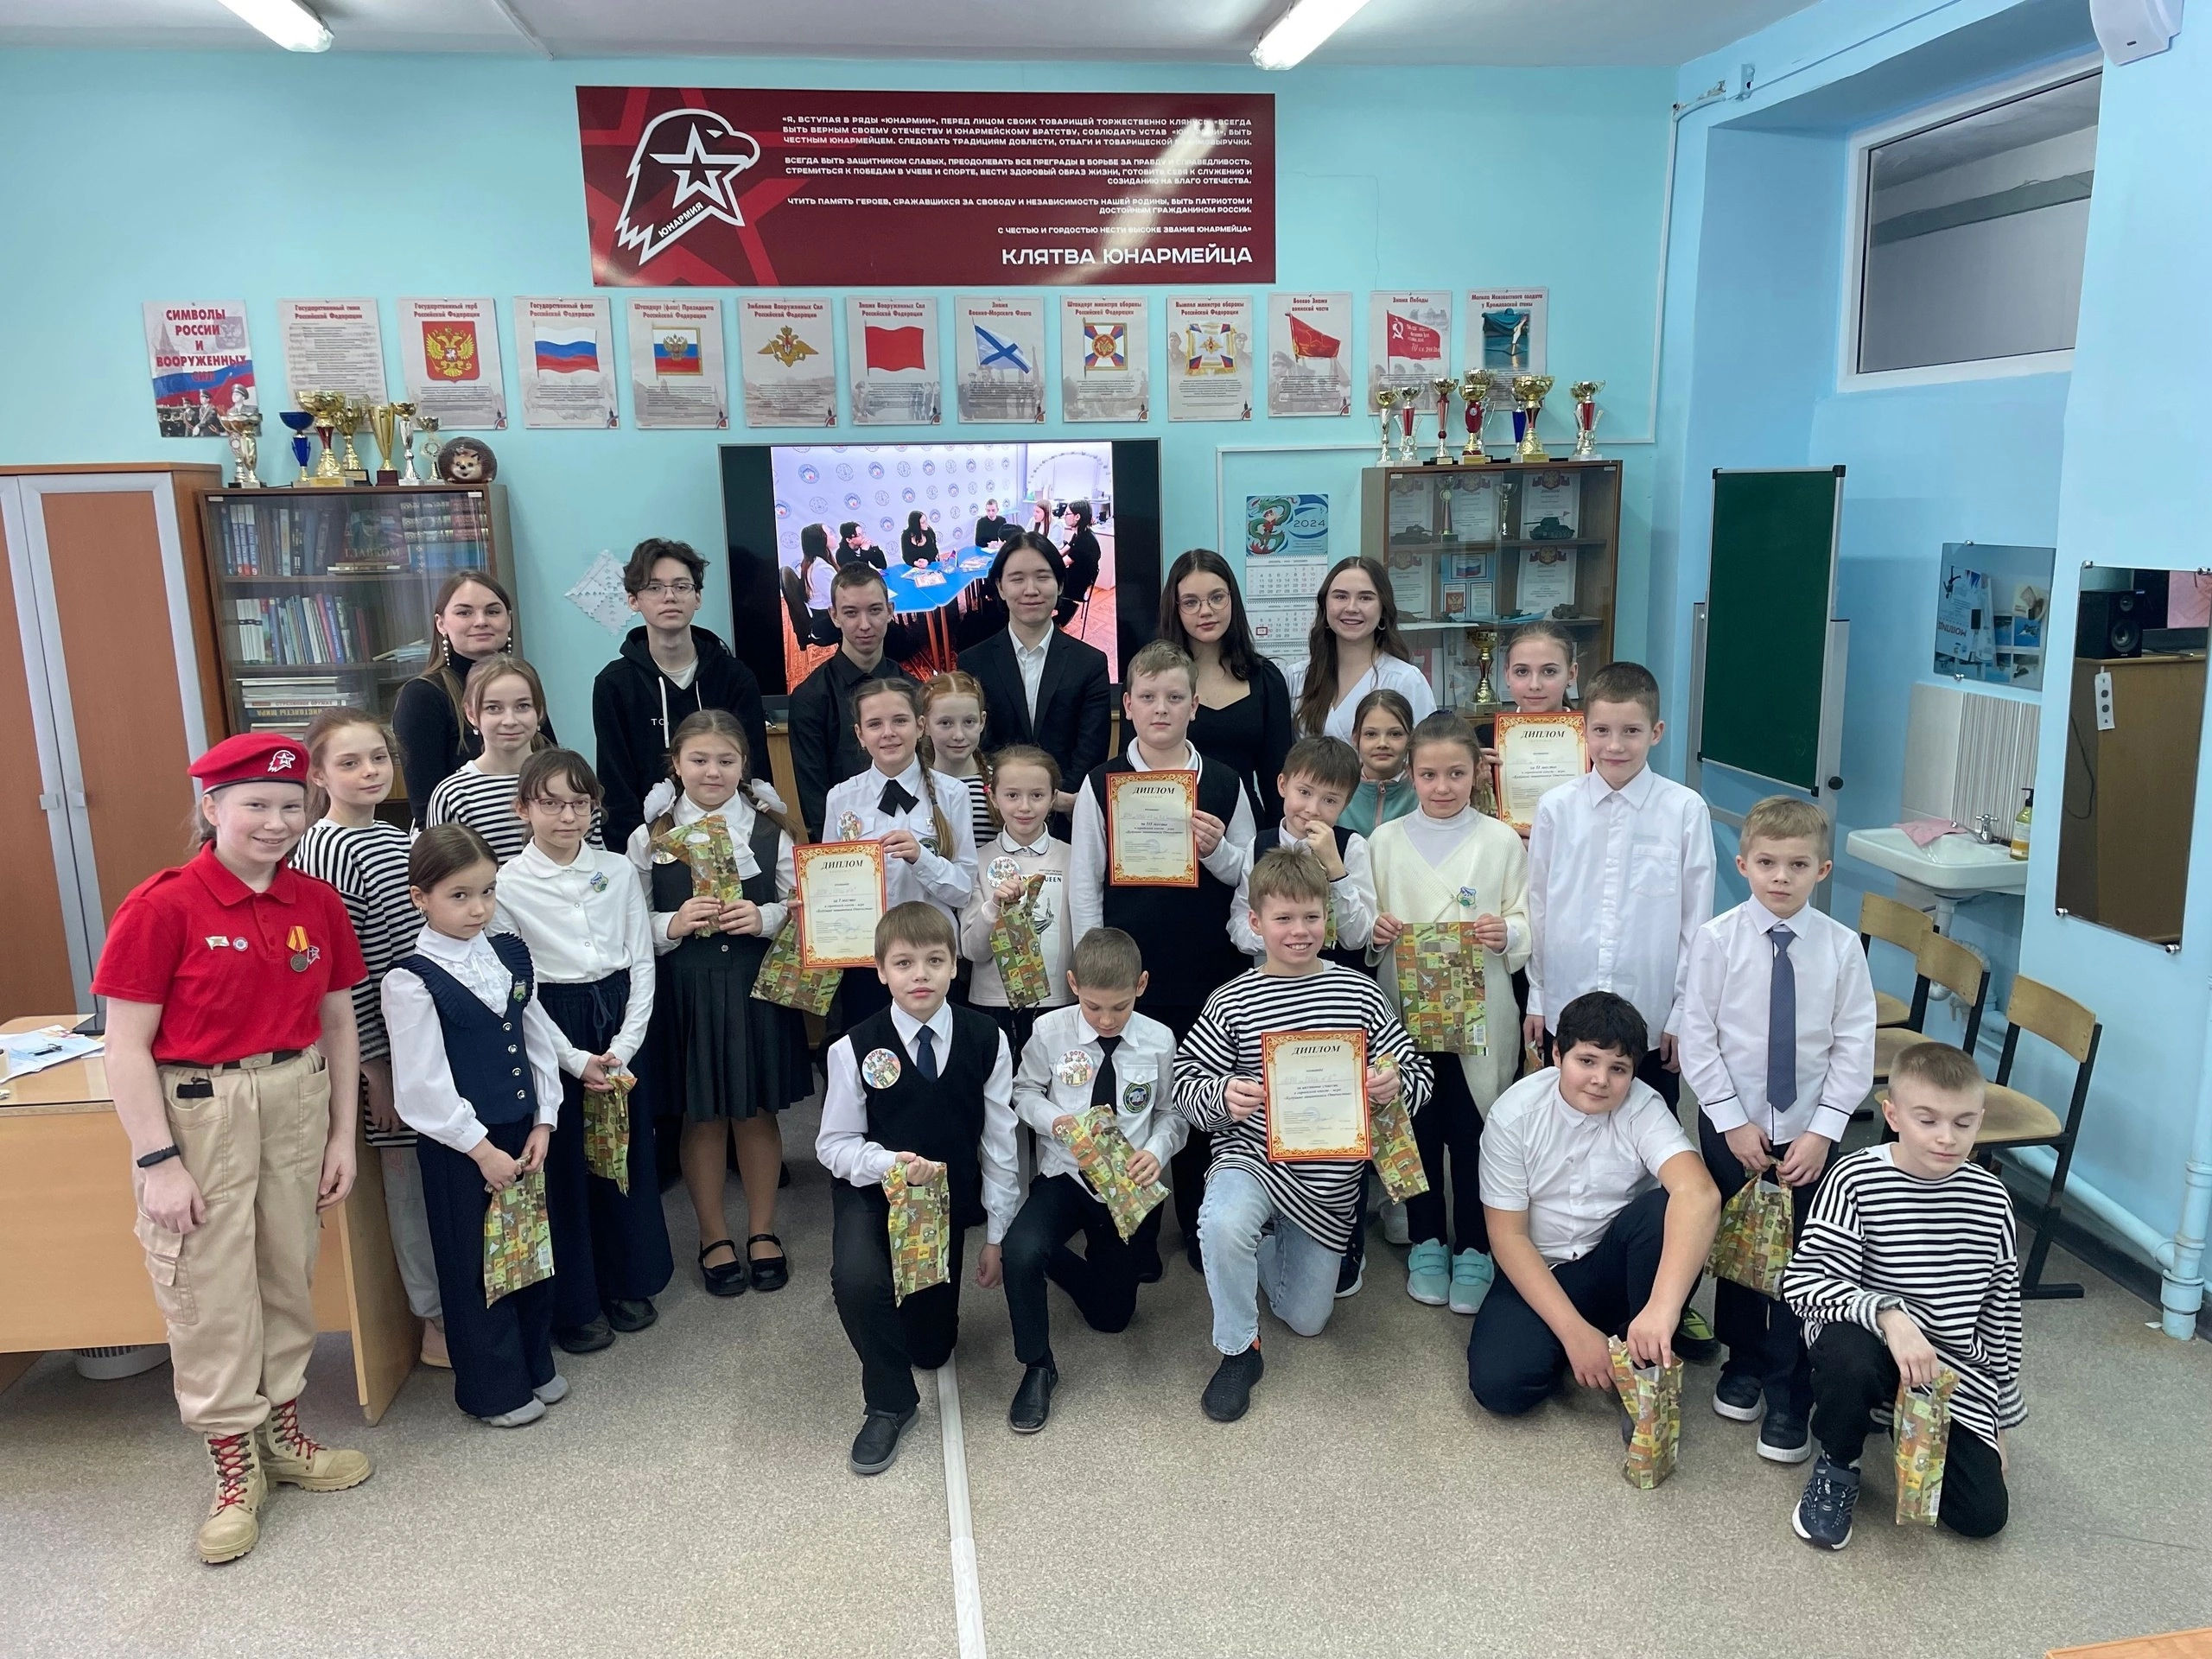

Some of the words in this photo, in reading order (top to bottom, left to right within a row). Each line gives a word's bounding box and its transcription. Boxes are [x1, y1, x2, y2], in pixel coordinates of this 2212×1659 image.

[782, 115, 795, 124] «Я,
[852, 116, 878, 124] РЯДЫ
[940, 117, 970, 125] ПЕРЕД
[1096, 118, 1166, 126] ТОРЖЕСТВЕННО
[810, 125, 849, 134] ВЕРНЫМ
[891, 126, 943, 135] ОТЕЧЕСТВУ
[954, 127, 1029, 136] ЮНАРМЕЙСКОМУ
[1082, 128, 1136, 137] СОБЛЮДАТЬ
[1139, 128, 1167, 137] УСТАВ
[1229, 128, 1252, 137] БЫТЬ
[783, 136, 827, 144] ЧЕСТНЫМ
[898, 137, 950, 145] СЛЕДОВАТЬ
[952, 137, 1006, 146] ТРАДИЦИЯМ
[1008, 137, 1057, 146] ДОБЛЕСТИ,
[1058, 137, 1092, 146] ОТВАГИ
[1102, 138, 1173, 147] ТОВАРИЩЕСКОЙ
[785, 156, 819, 165] ВСЕГДА
[820, 156, 845, 165] БЫТЬ
[846, 156, 906, 165] ЗАЩИТНИКОМ
[948, 157, 1014, 166] ПРЕОДОЛЕВАТЬ
[1120, 158, 1132, 167] ЗА
[785, 166, 843, 175] СТРЕМИТЬСЯ
[853, 167, 895, 175] ПОБЕДАМ
[897, 167, 904, 175] В
[1009, 168, 1056, 176] ЗДОРОВЫЙ
[1058, 168, 1086, 176] ОБРАЗ
[1088, 168, 1120, 176] ЖИЗНИ,
[1190, 168, 1195, 176] К
[1198, 168, 1245, 176] СЛУЖЕНИЮ
[1246, 168, 1252, 176] И
[1174, 177, 1201, 186] БЛАГО
[1203, 177, 1252, 186] ОТЕЧЕСТВА.
[855, 197, 891, 206] ГЕРОЕВ,
[976, 198, 1015, 207] СВОБОДУ
[1132, 197, 1169, 206] РОДИНЫ,
[1153, 206, 1217, 214] ГРАЖДАНИНОМ
[1217, 206, 1252, 214] РОССИИ.
[658, 201, 704, 238] ЮНАРМИЯ
[1099, 226, 1126, 234] НЕСТИ
[1163, 226, 1196, 234] ЗВАНИЕ
[1001, 247, 1096, 265] КЛЯТВА
[1103, 243, 1253, 266] ЮНАРМЕЙЦА
[165, 308, 226, 321] СИМВОЛЫ
[175, 325, 220, 336] РОССИИ
[195, 340, 204, 351] И
[156, 355, 246, 367] ВООРУЖЕННЫХ
[1293, 519, 1325, 528] 2024
[1520, 730, 1566, 739] ДИПЛОМ
[1132, 786, 1176, 795] ДИПЛОМ
[821, 859, 864, 870] ДИПЛОМ
[1291, 1045, 1341, 1056] ДИПЛОМ
